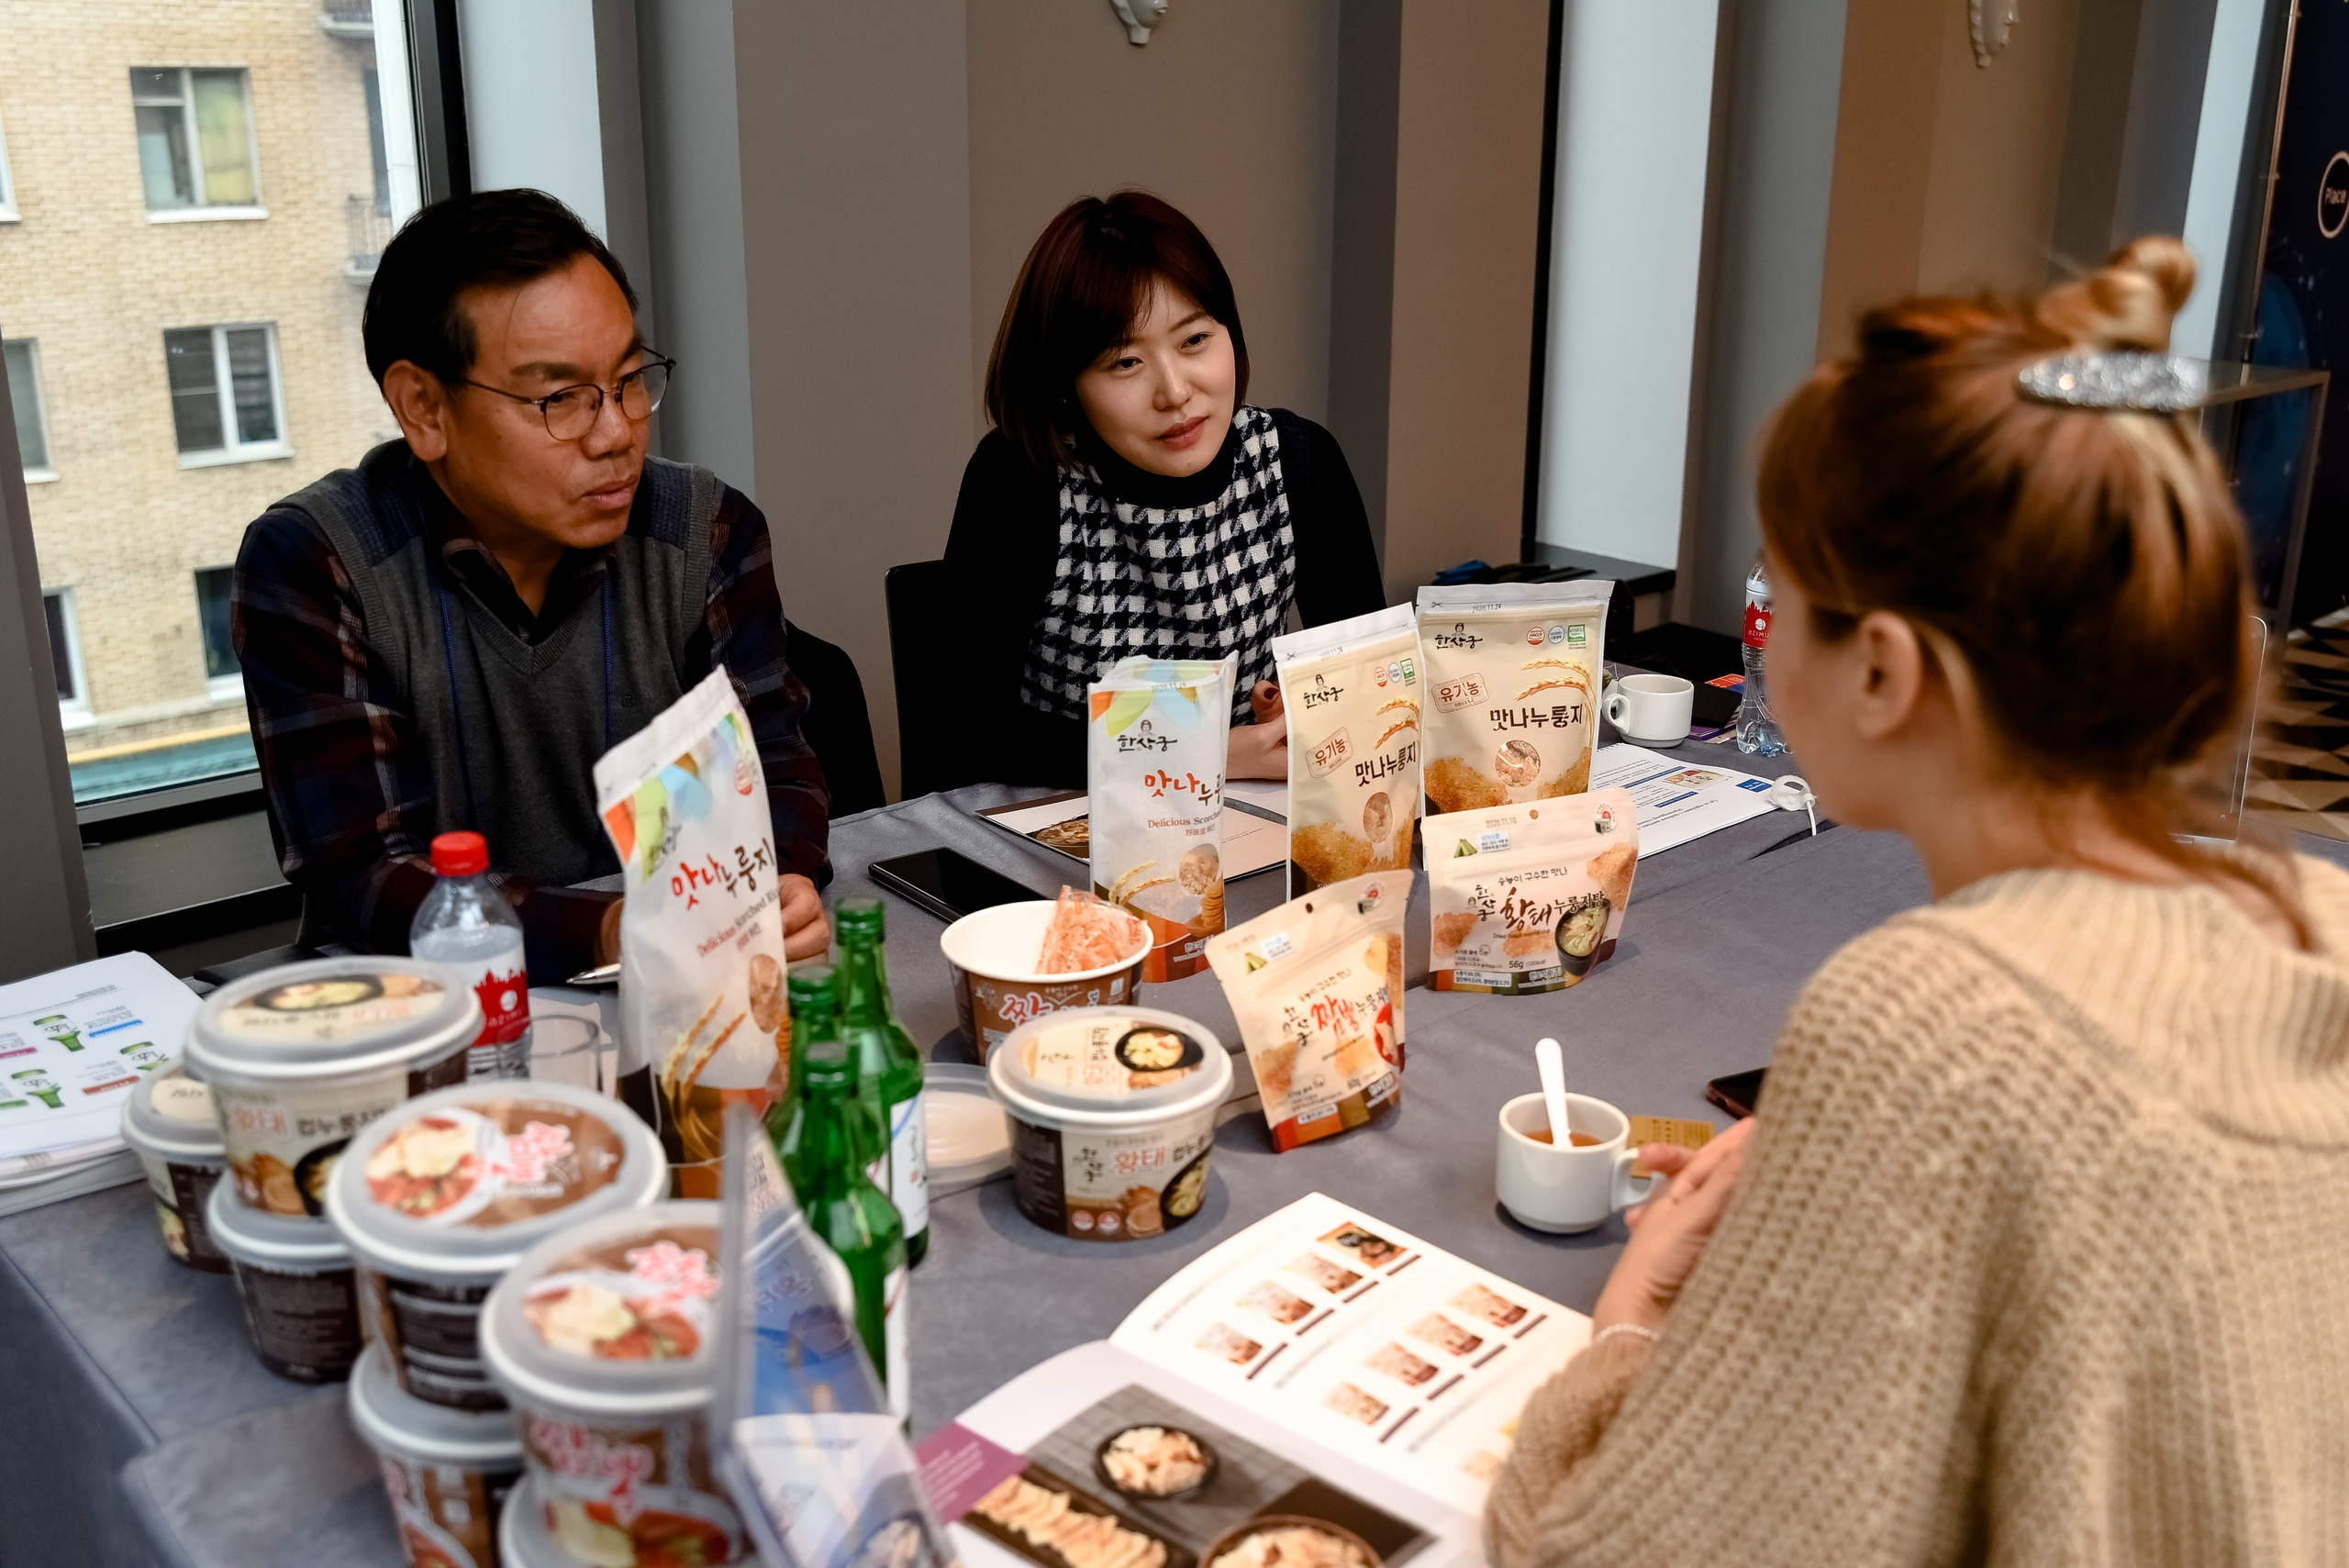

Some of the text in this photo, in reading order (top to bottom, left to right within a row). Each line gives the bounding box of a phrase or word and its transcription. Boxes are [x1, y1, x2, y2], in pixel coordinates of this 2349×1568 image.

[1434, 634, 1484, 650] 한상궁
[1303, 687, 1344, 710] 한상궁
[1440, 681, 1480, 703] 유기농
[1489, 703, 1584, 732] 맛나누룽지
[1117, 735, 1178, 753] 한상궁
[1315, 738, 1347, 767] 유기농
[1354, 741, 1417, 787] 맛나누룽지
[1148, 817, 1191, 828] Delicious
[671, 838, 776, 911] 맛나누룽지
[1524, 871, 1549, 882] 구수한
[1550, 867, 1568, 878] 맛나
[1499, 886, 1606, 932] 황태 누룽지탕
[1492, 932, 1507, 940] Dried
[1508, 959, 1524, 969] 56g
